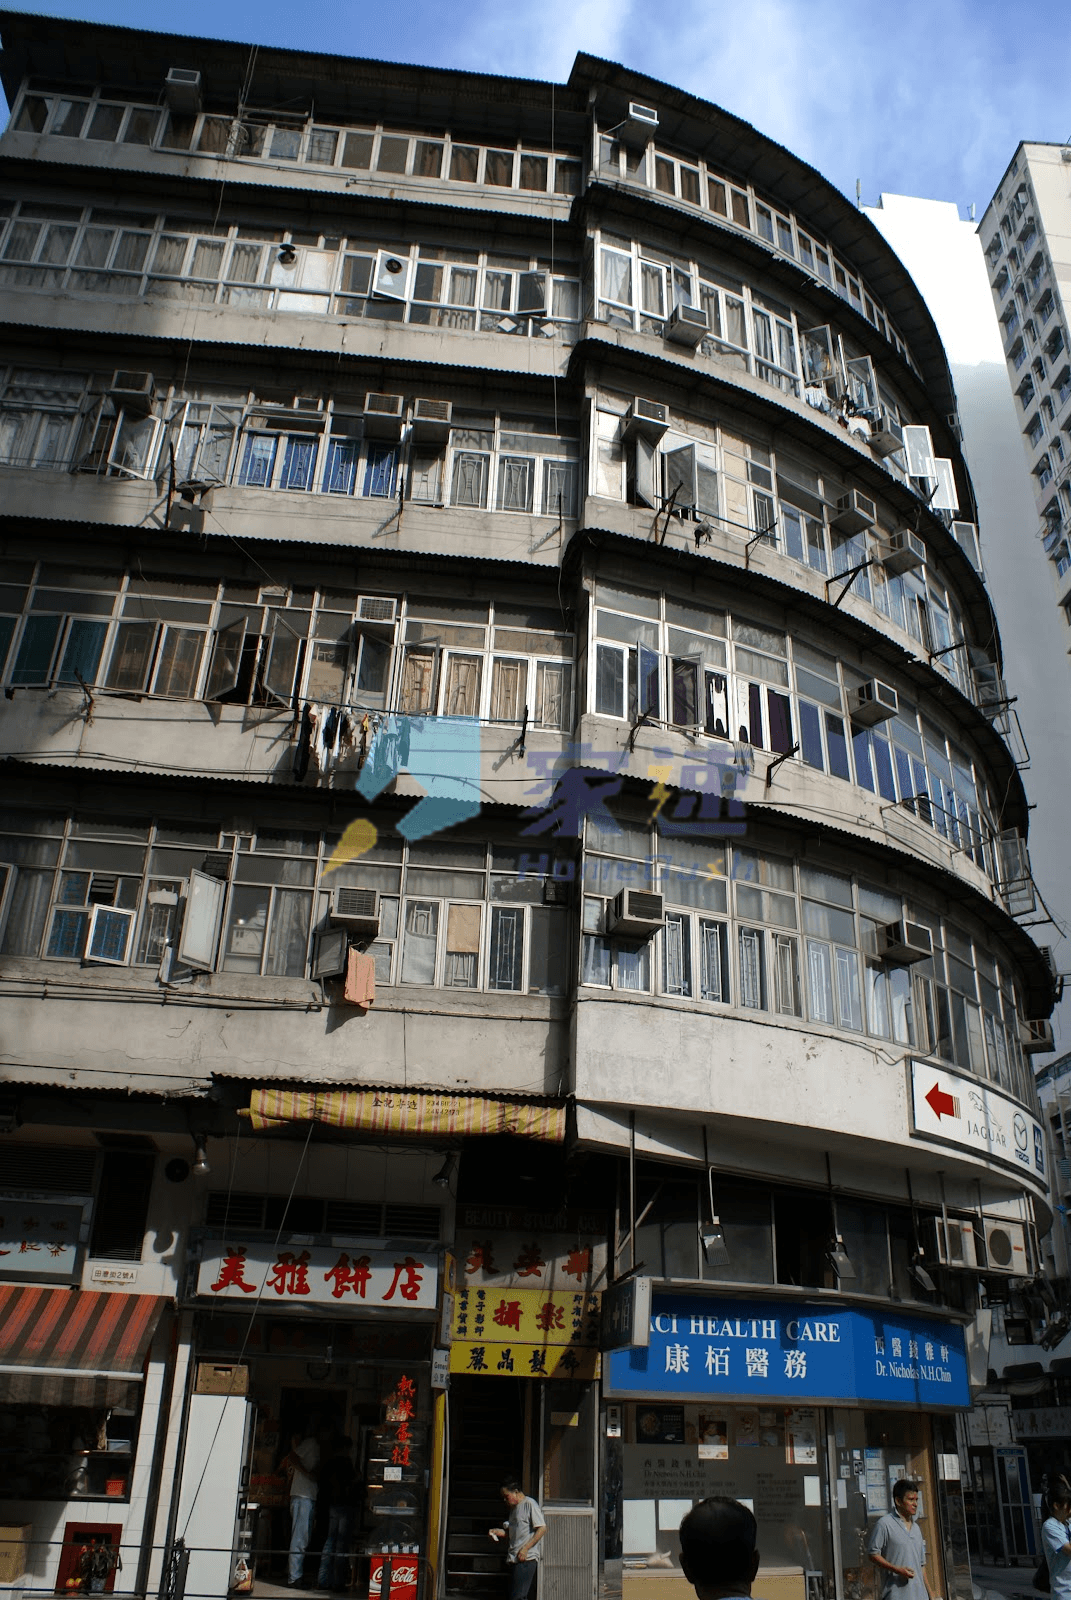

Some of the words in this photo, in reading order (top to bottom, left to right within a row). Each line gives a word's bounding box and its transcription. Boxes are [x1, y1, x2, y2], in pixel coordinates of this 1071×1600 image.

[967, 1120, 1007, 1147] JAGUAR
[210, 1246, 425, 1301] 美雅餅店
[492, 1299, 566, 1332] 攝影
[689, 1314, 777, 1340] HEALTH
[786, 1320, 841, 1342] CARE
[664, 1343, 808, 1379] 康栢醫務
[875, 1360, 889, 1377] Dr.
[889, 1361, 920, 1380] Nicholas
[920, 1364, 952, 1383] N.H.Chin
